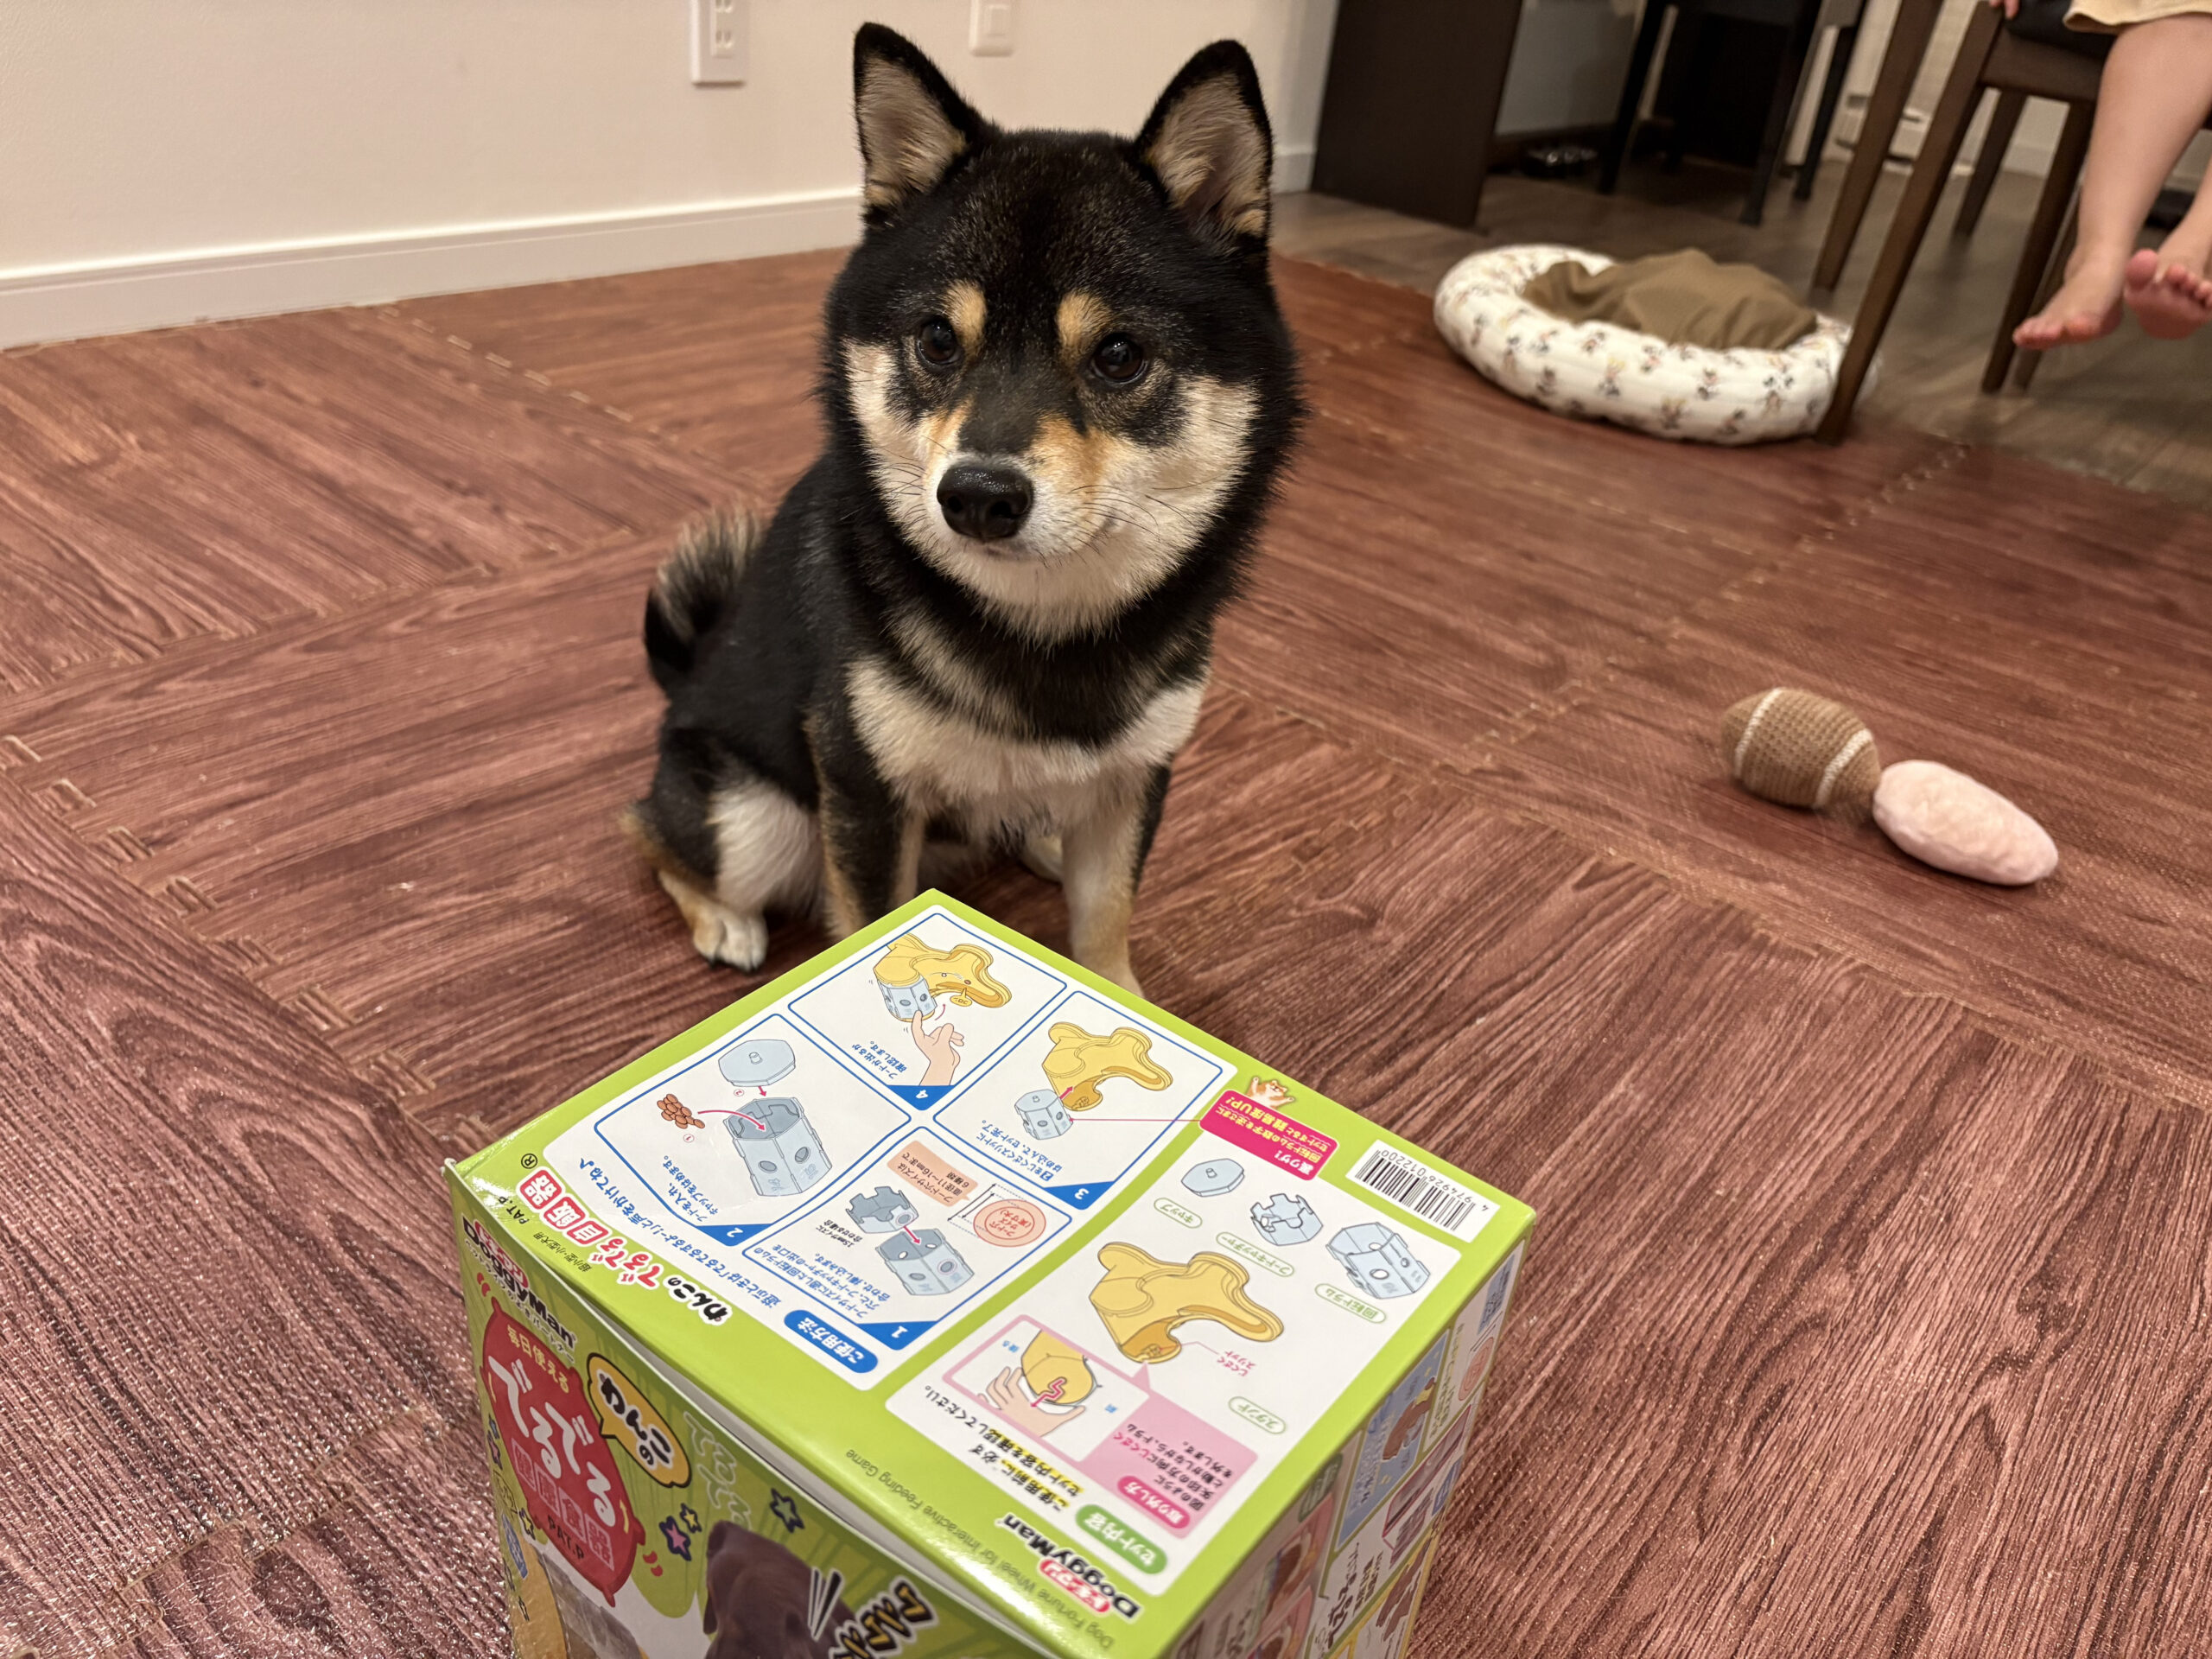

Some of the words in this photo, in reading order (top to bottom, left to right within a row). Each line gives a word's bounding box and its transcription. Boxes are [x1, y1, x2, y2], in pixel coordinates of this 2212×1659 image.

[912, 1088, 931, 1100] 4
[1071, 1186, 1090, 1200] 3
[725, 1225, 744, 1238] 2
[462, 1216, 573, 1349] DoggyMan
[795, 1316, 865, 1364] ご使用方法
[889, 1325, 908, 1339] 1
[842, 1448, 880, 1477] Game
[874, 1470, 924, 1509] Feeding
[1001, 1514, 1140, 1619] DoggyMan
